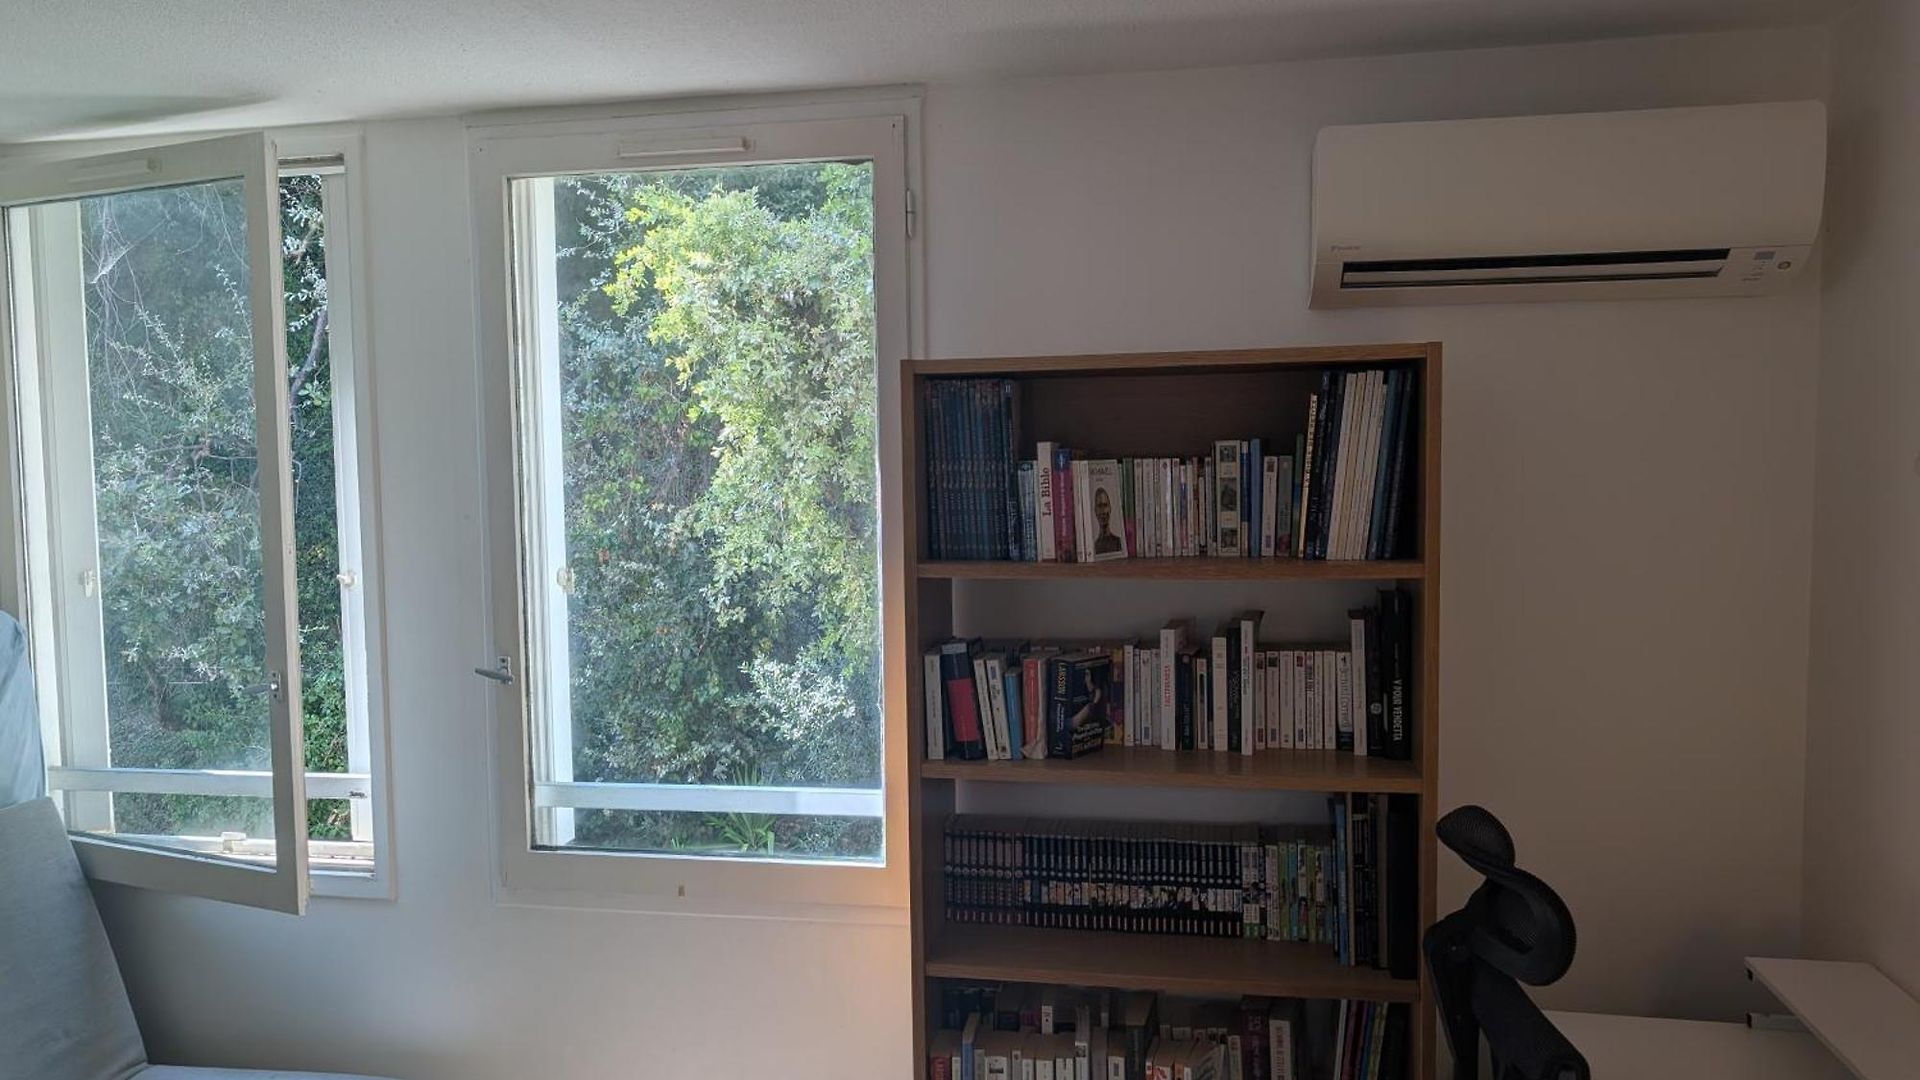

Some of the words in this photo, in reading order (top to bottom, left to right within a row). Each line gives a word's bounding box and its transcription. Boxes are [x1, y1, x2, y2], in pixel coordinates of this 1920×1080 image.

[1041, 468, 1050, 497] Bible
[1043, 502, 1051, 515] La
[1394, 679, 1402, 687] V
[1393, 686, 1402, 705] POUR
[1393, 706, 1402, 741] VENDETTA
